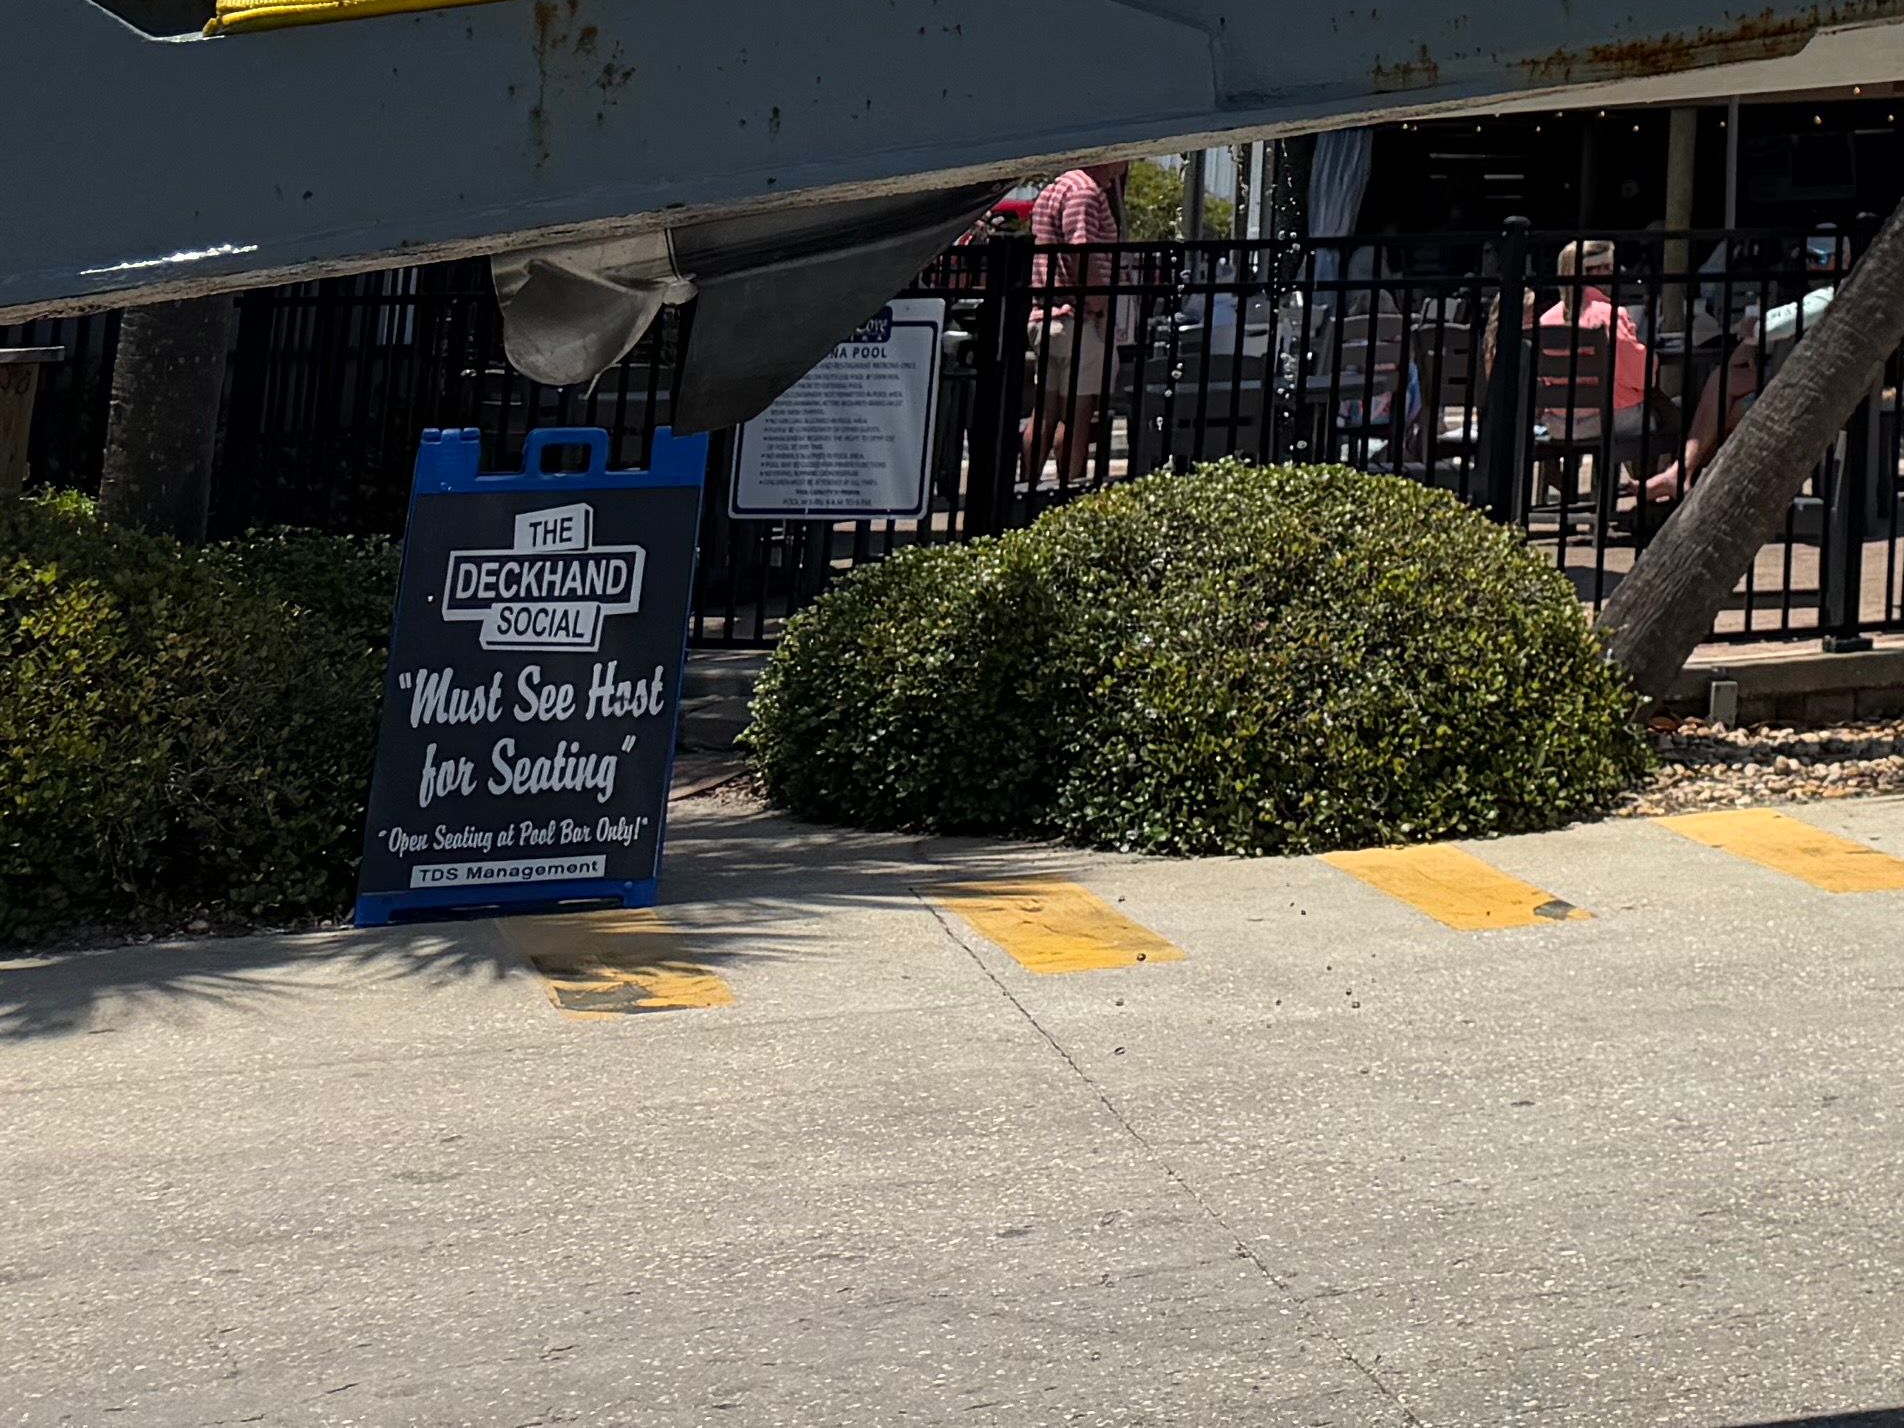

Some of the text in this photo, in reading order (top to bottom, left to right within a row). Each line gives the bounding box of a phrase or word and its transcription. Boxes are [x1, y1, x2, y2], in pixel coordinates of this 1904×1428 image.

[852, 346, 888, 359] POOL
[529, 517, 573, 547] THE
[456, 559, 628, 599] DECKHAND
[497, 606, 585, 638] SOCIAL
[513, 665, 576, 721] See
[585, 660, 664, 720] Host
[419, 743, 477, 808] for
[432, 824, 492, 853] Seating
[497, 823, 515, 847] at
[519, 820, 556, 846] Pool
[559, 818, 592, 844] Bar
[419, 860, 599, 882] TDS Management
